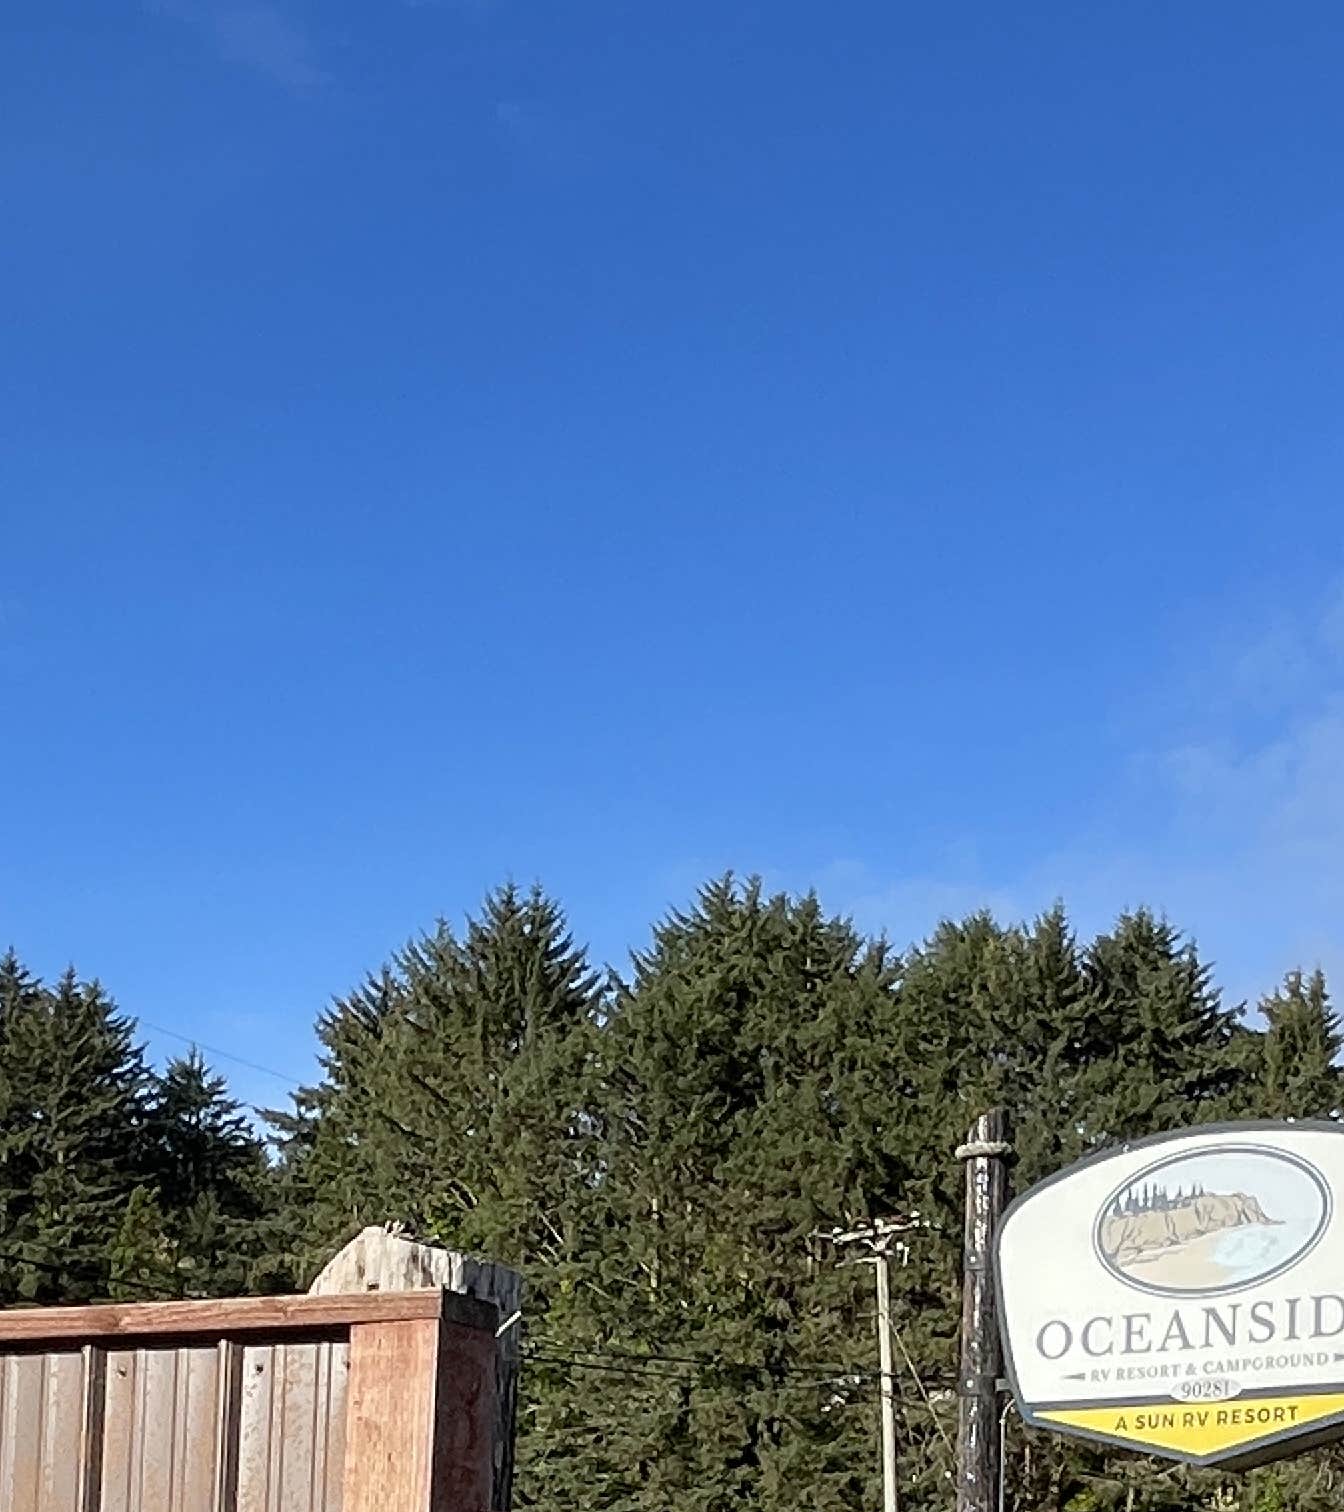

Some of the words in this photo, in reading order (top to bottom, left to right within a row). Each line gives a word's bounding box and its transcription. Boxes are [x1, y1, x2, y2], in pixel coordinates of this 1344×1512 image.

[1090, 1368, 1110, 1382] RV
[1116, 1363, 1182, 1380] RESORT
[1185, 1362, 1197, 1376] &
[1202, 1352, 1329, 1375] CAMPGROUND
[1115, 1416, 1128, 1432] A
[1135, 1413, 1175, 1430] SUN
[1182, 1411, 1208, 1427] RV
[1216, 1405, 1299, 1425] RESORT
